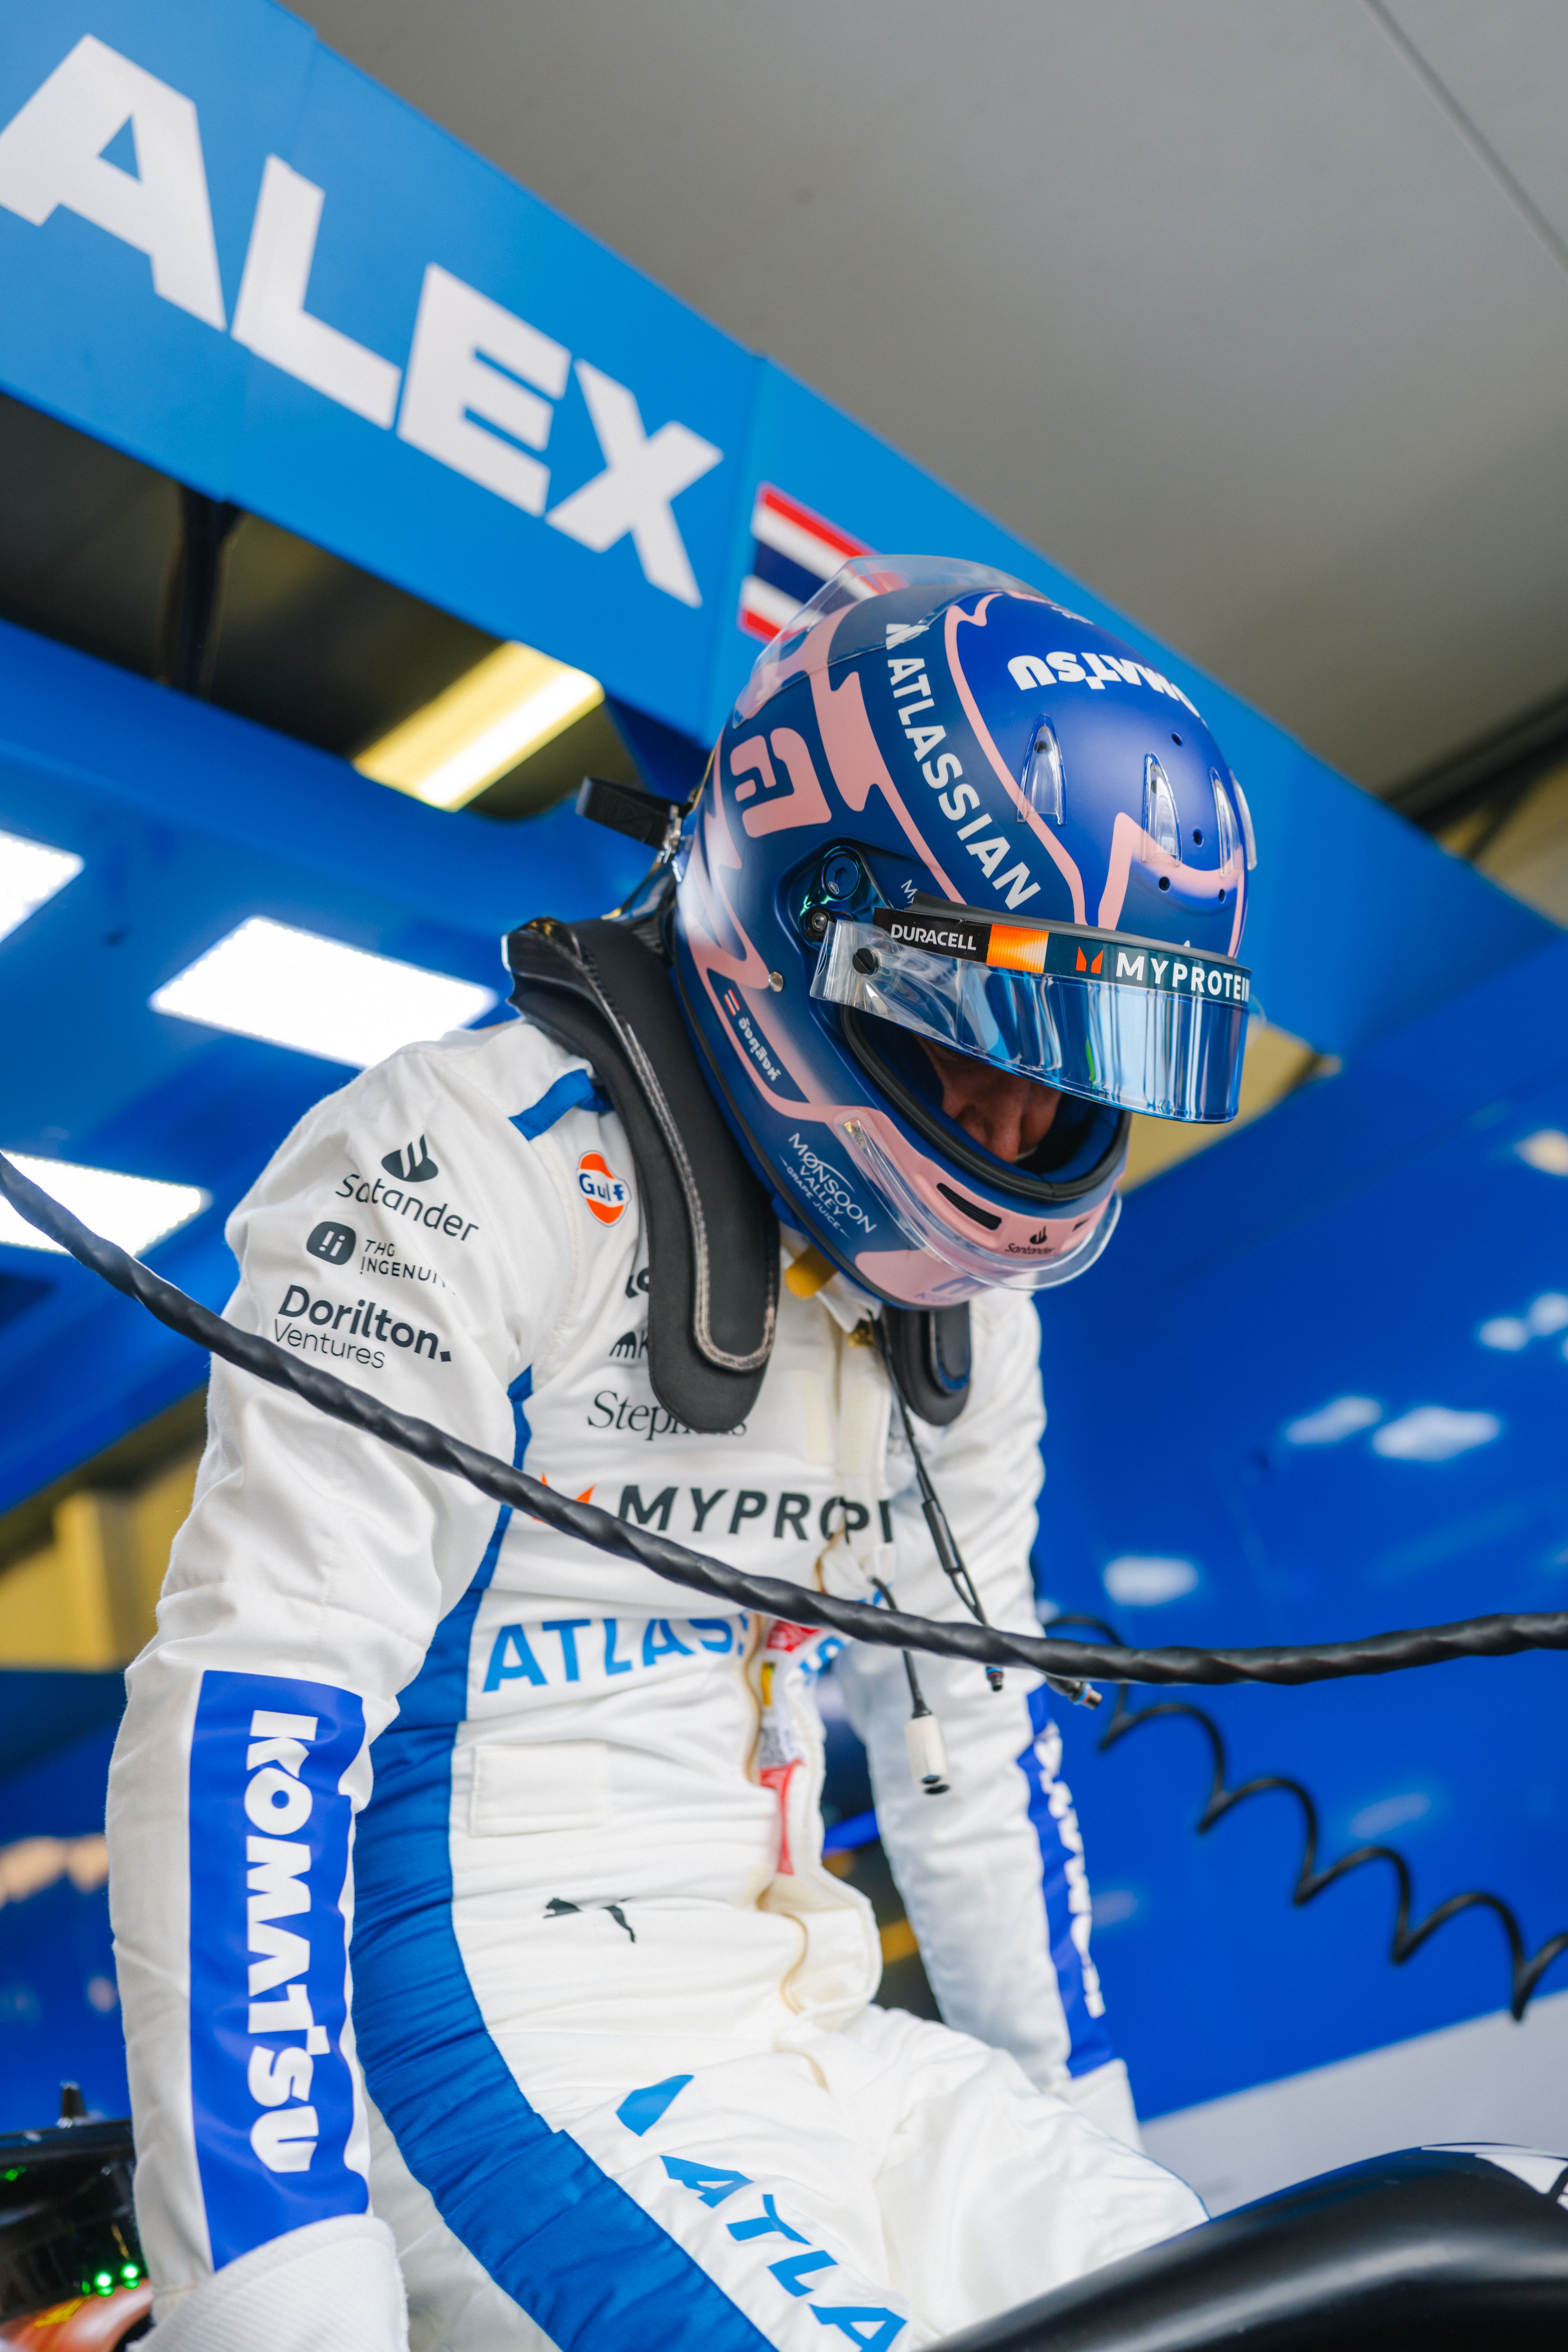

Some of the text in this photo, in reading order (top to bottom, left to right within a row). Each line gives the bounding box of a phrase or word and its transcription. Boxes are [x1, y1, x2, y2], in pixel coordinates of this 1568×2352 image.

[0, 33, 724, 608] ALEX
[887, 658, 1041, 910] ATLASSIAN
[891, 924, 976, 951] DURACELL
[579, 1173, 624, 1202] Gulf
[786, 1166, 841, 1229] GRAPE JUICE
[800, 1165, 844, 1215] VALLEY
[365, 1239, 395, 1257] THG
[274, 1319, 385, 1369] Ventures
[244, 1710, 330, 2173] KOMATSU
